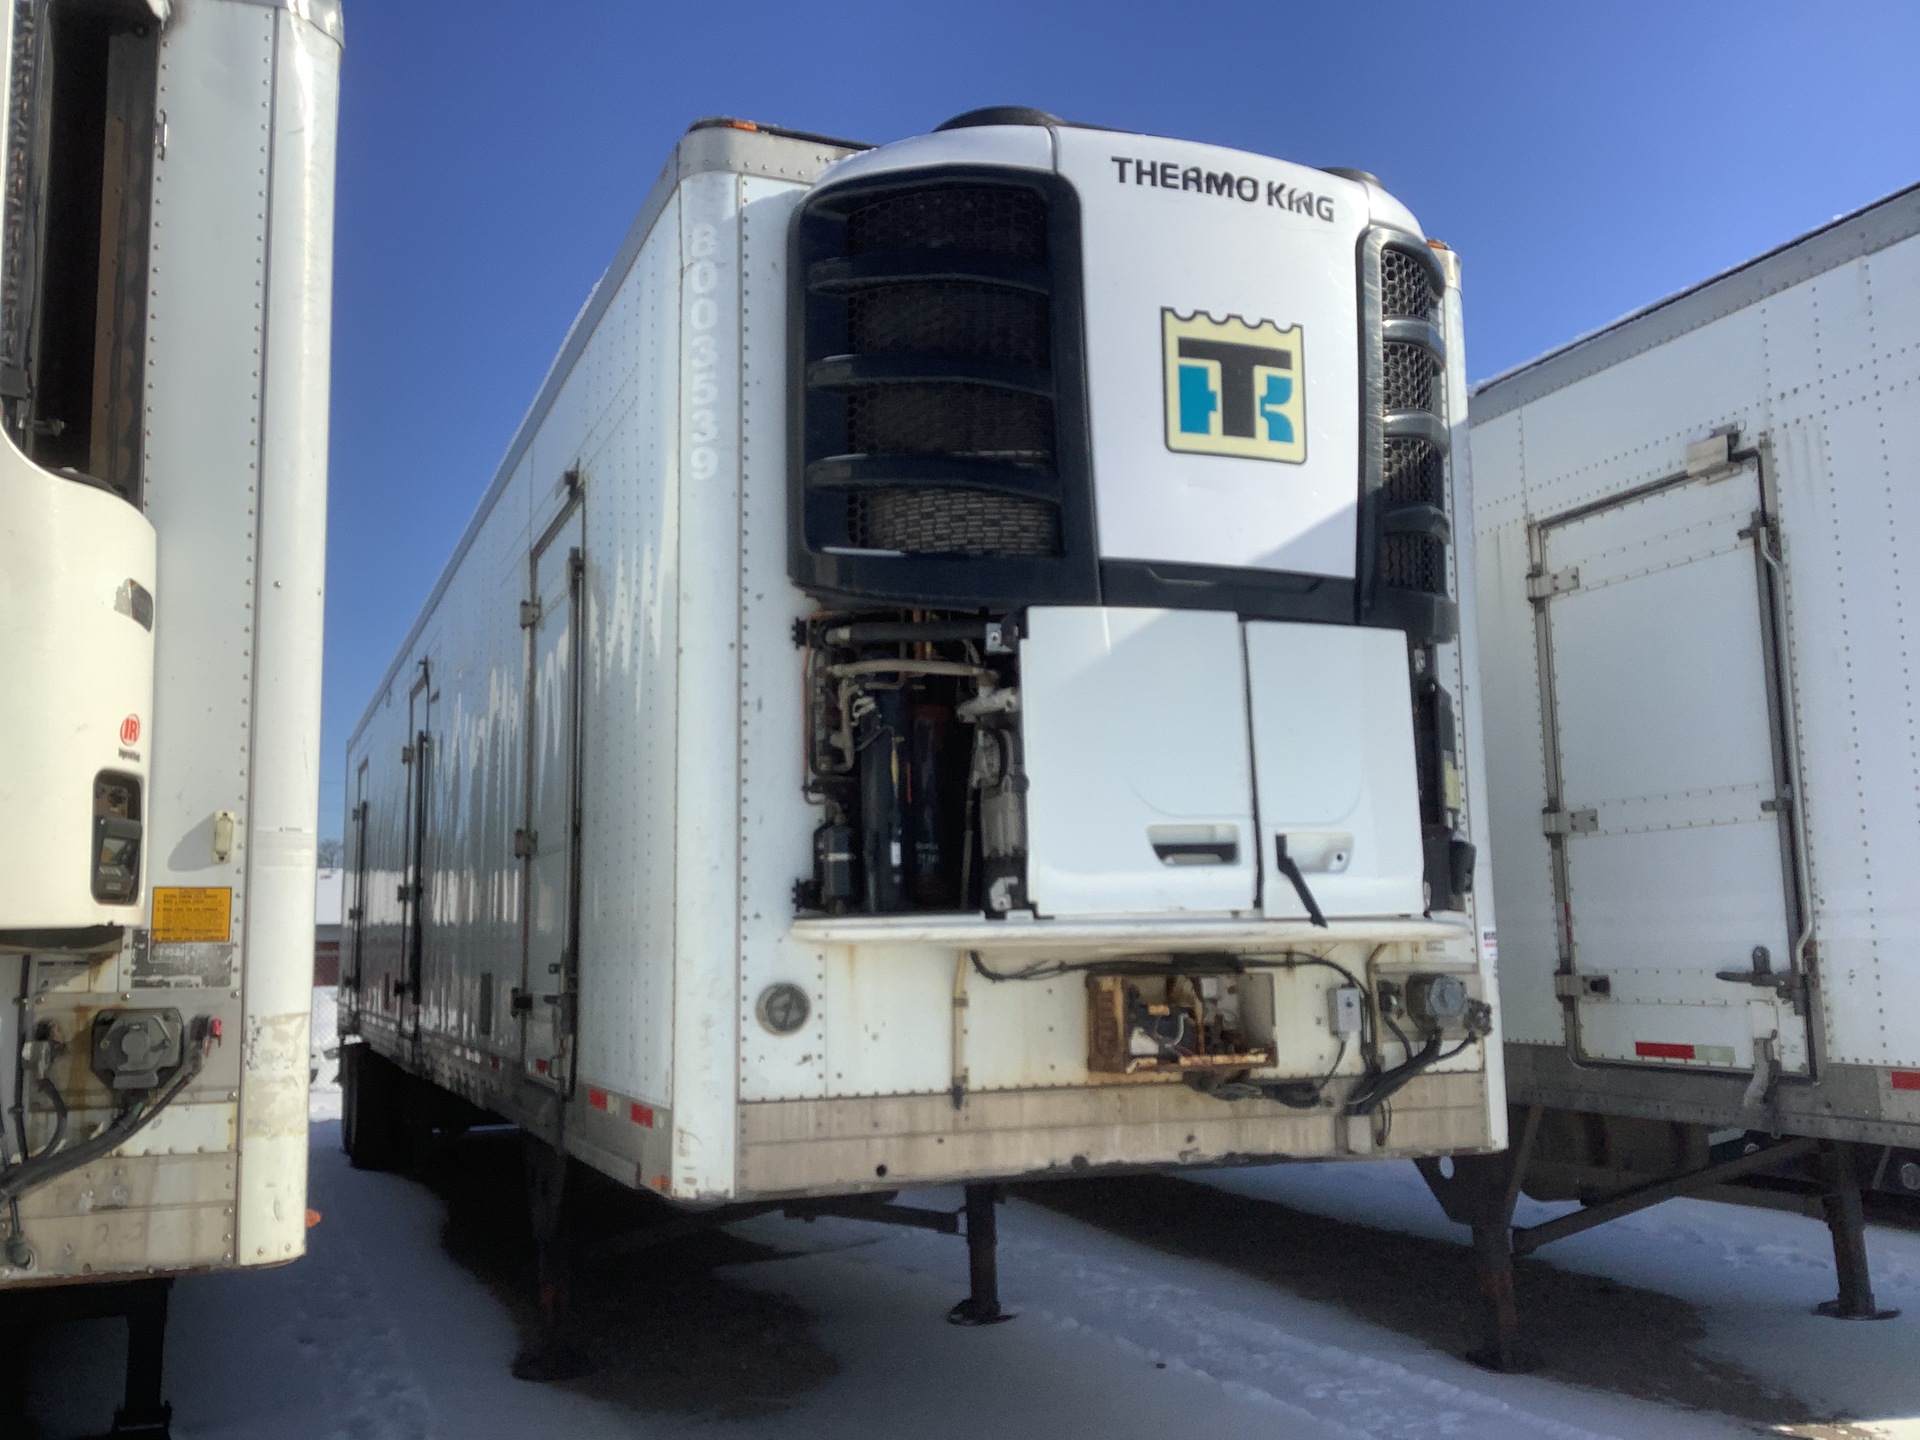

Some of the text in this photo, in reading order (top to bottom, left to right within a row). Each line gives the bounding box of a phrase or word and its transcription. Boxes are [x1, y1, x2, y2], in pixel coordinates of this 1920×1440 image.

[1111, 156, 1335, 223] THERMO KING
[690, 223, 719, 480] 8003539
[123, 718, 138, 742] IR
